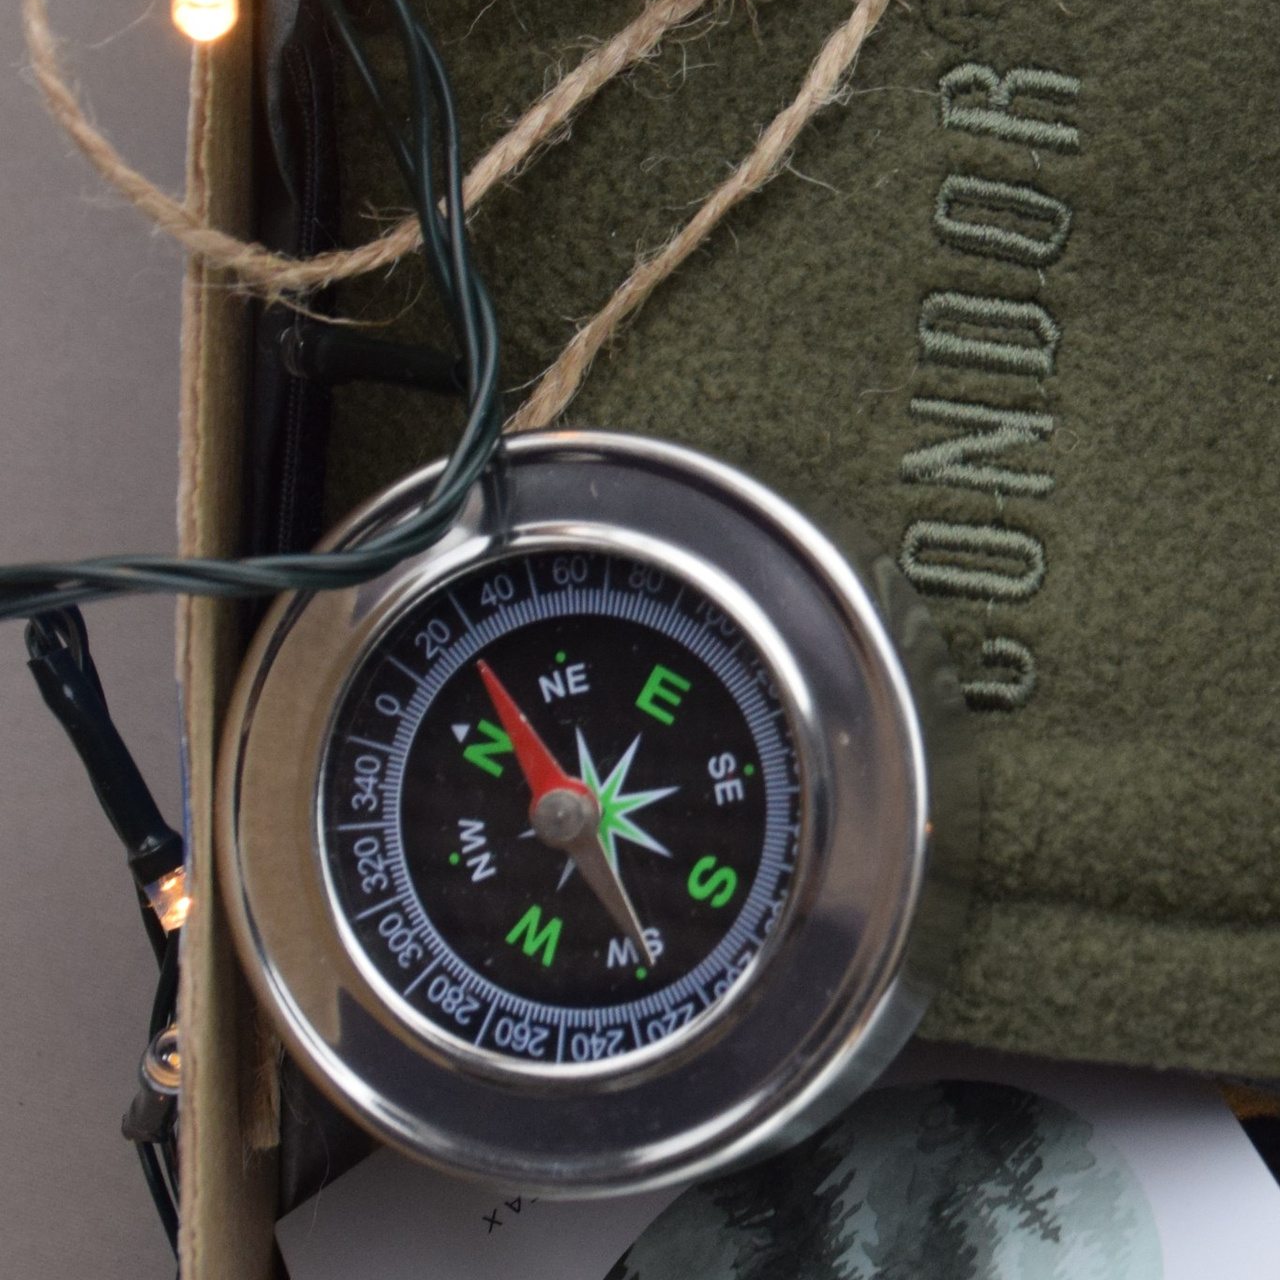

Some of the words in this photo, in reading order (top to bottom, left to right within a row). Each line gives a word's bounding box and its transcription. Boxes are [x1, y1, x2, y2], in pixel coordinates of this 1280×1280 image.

[480, 574, 515, 606] 40
[552, 554, 588, 585] 60
[628, 563, 665, 593] 80
[414, 619, 451, 660] 20
[375, 693, 400, 717] 0
[538, 662, 590, 704] NE
[635, 663, 692, 726] E
[463, 719, 514, 778] N
[351, 755, 381, 813] 340
[707, 751, 744, 807] SE
[353, 835, 388, 894] 320
[457, 818, 497, 883] NW
[687, 855, 738, 909] S
[378, 912, 424, 969] 300
[505, 904, 563, 968] W
[606, 926, 664, 968] SW
[427, 973, 480, 1025] 280
[494, 1017, 551, 1057] 260
[570, 1029, 625, 1061] 240
